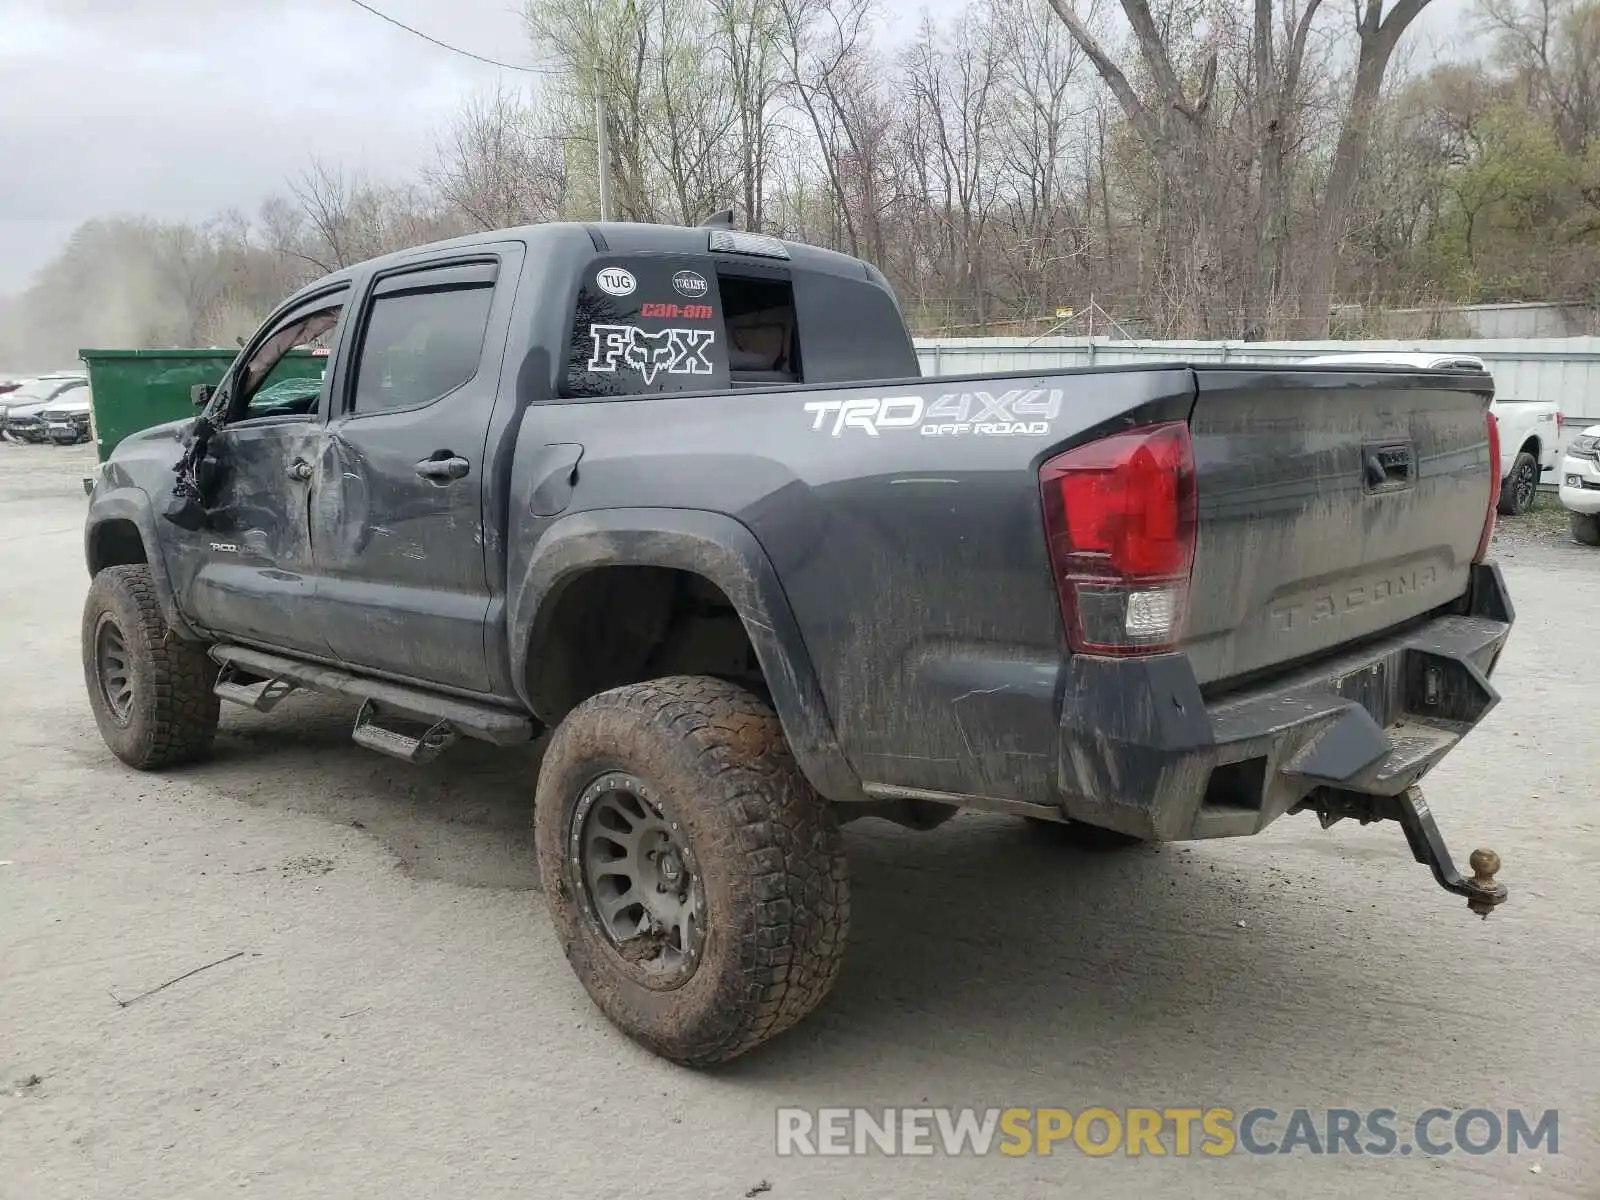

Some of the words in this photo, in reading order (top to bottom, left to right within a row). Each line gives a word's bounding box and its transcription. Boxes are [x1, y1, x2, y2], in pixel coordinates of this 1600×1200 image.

[603, 275, 632, 289] TUG
[803, 396, 925, 438] TRD
[920, 422, 971, 437] OFF
[973, 421, 1050, 436] ROAD
[1271, 565, 1437, 633] TACOMA
